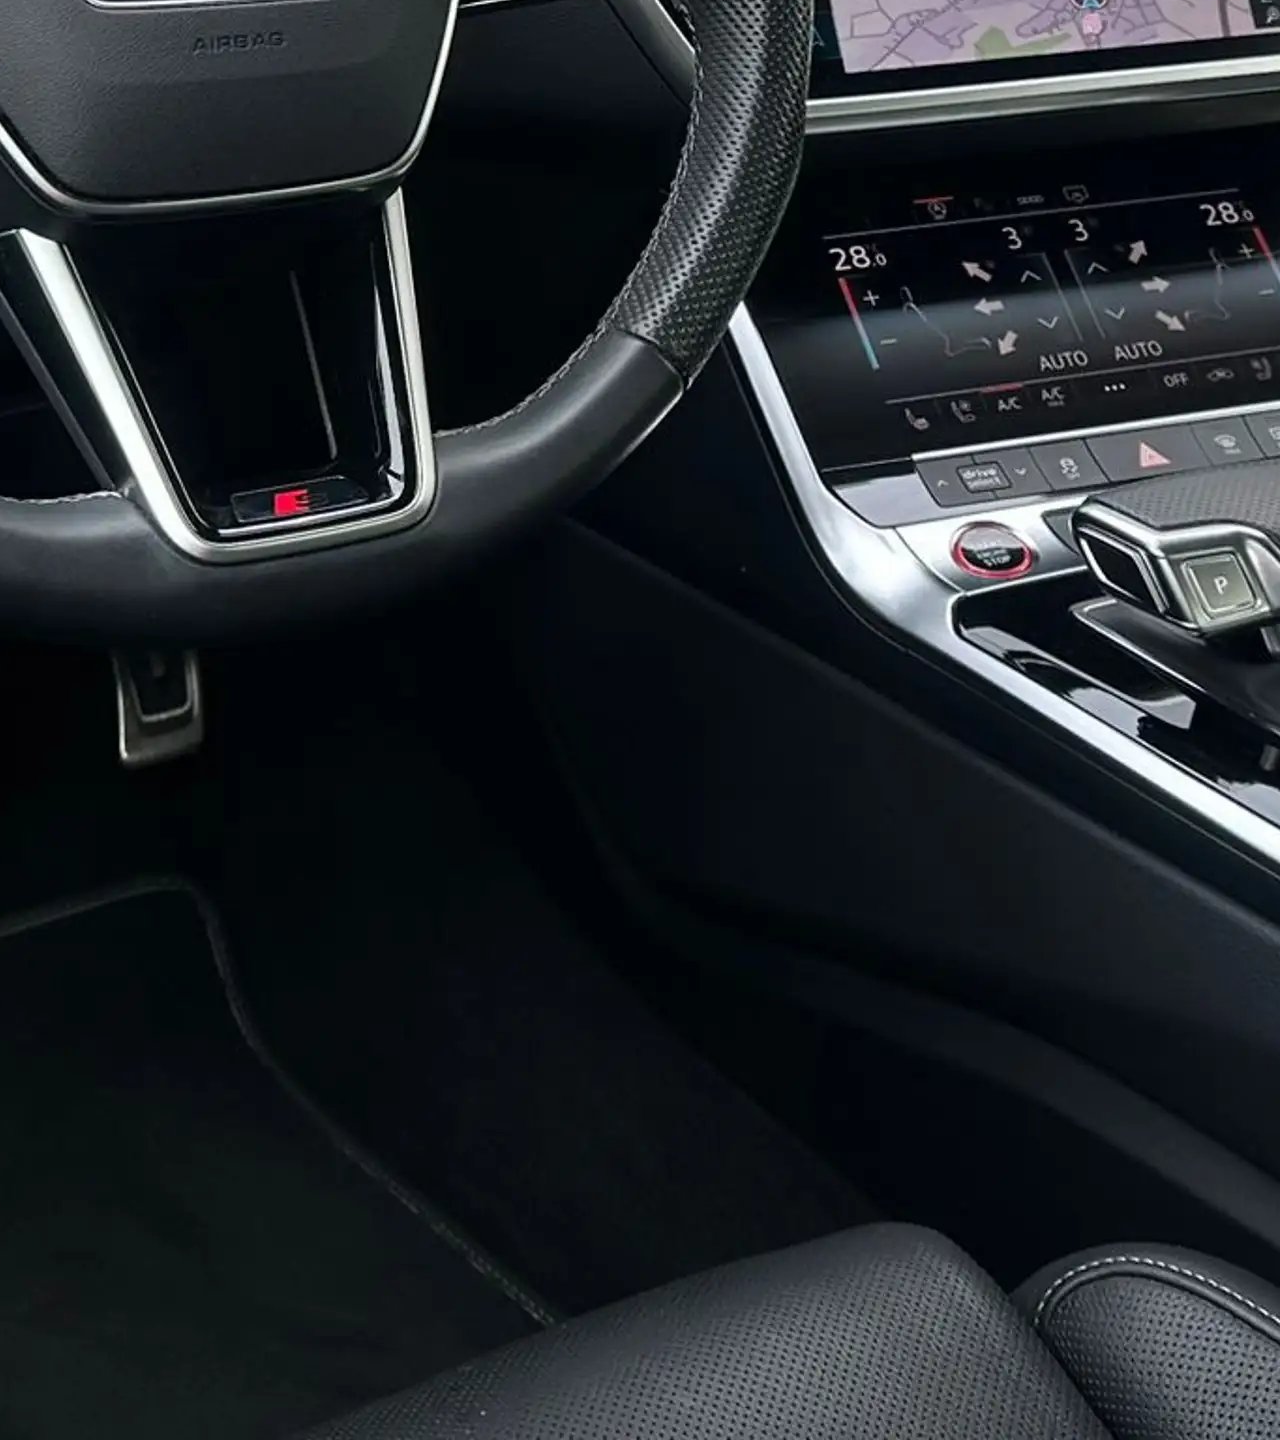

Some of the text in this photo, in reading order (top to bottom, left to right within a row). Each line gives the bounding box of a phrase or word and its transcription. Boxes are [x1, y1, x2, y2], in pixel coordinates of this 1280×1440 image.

[192, 30, 285, 55] AIRBAG
[1002, 226, 1023, 250] 3
[1068, 219, 1090, 242] 3
[828, 245, 888, 272] 28.0
[1039, 349, 1089, 372] AUTO
[1113, 339, 1163, 362] AUTO
[1163, 371, 1189, 388] OFF
[997, 396, 1023, 412] A/C
[1041, 386, 1066, 402] A/C
[1213, 575, 1228, 596] P
